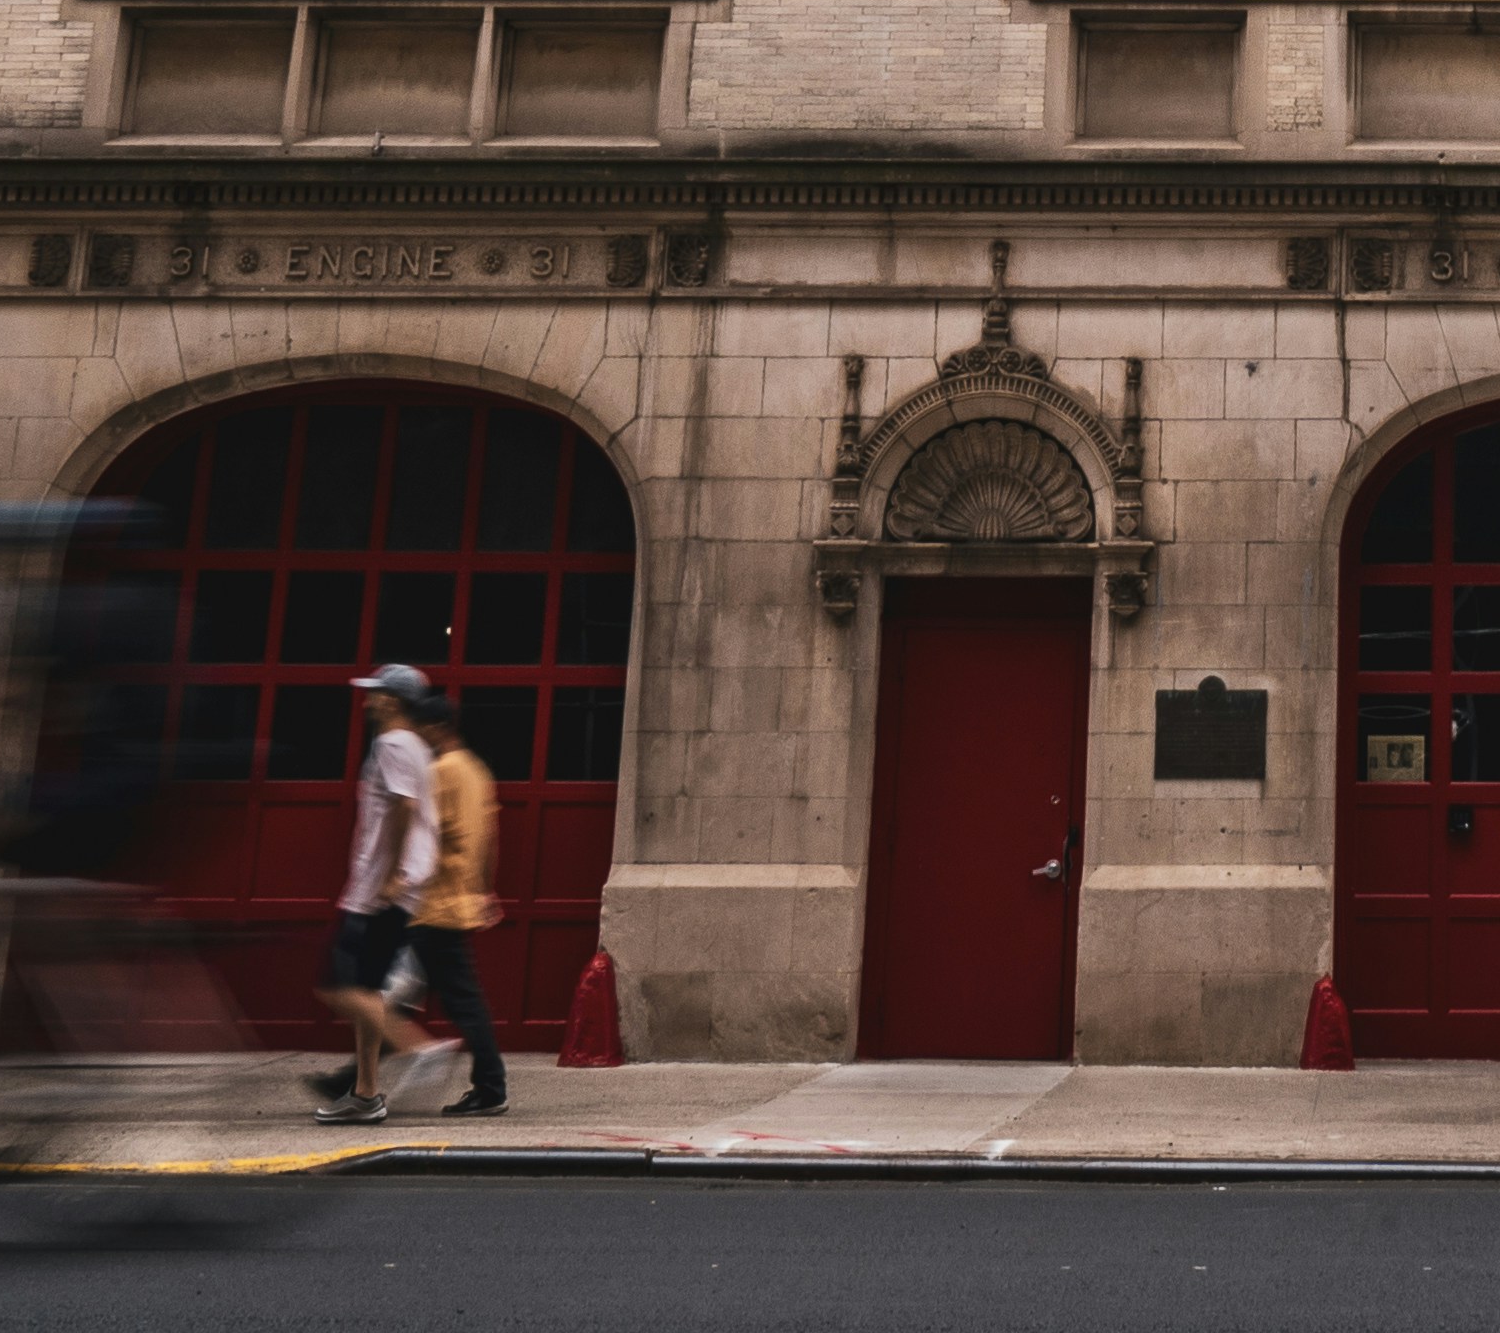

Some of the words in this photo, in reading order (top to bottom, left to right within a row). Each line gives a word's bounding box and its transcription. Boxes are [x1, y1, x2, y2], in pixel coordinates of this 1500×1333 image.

[169, 245, 212, 279] 31
[283, 244, 455, 281] ENGINE
[530, 245, 571, 279] 31
[1429, 249, 1469, 284] 31
